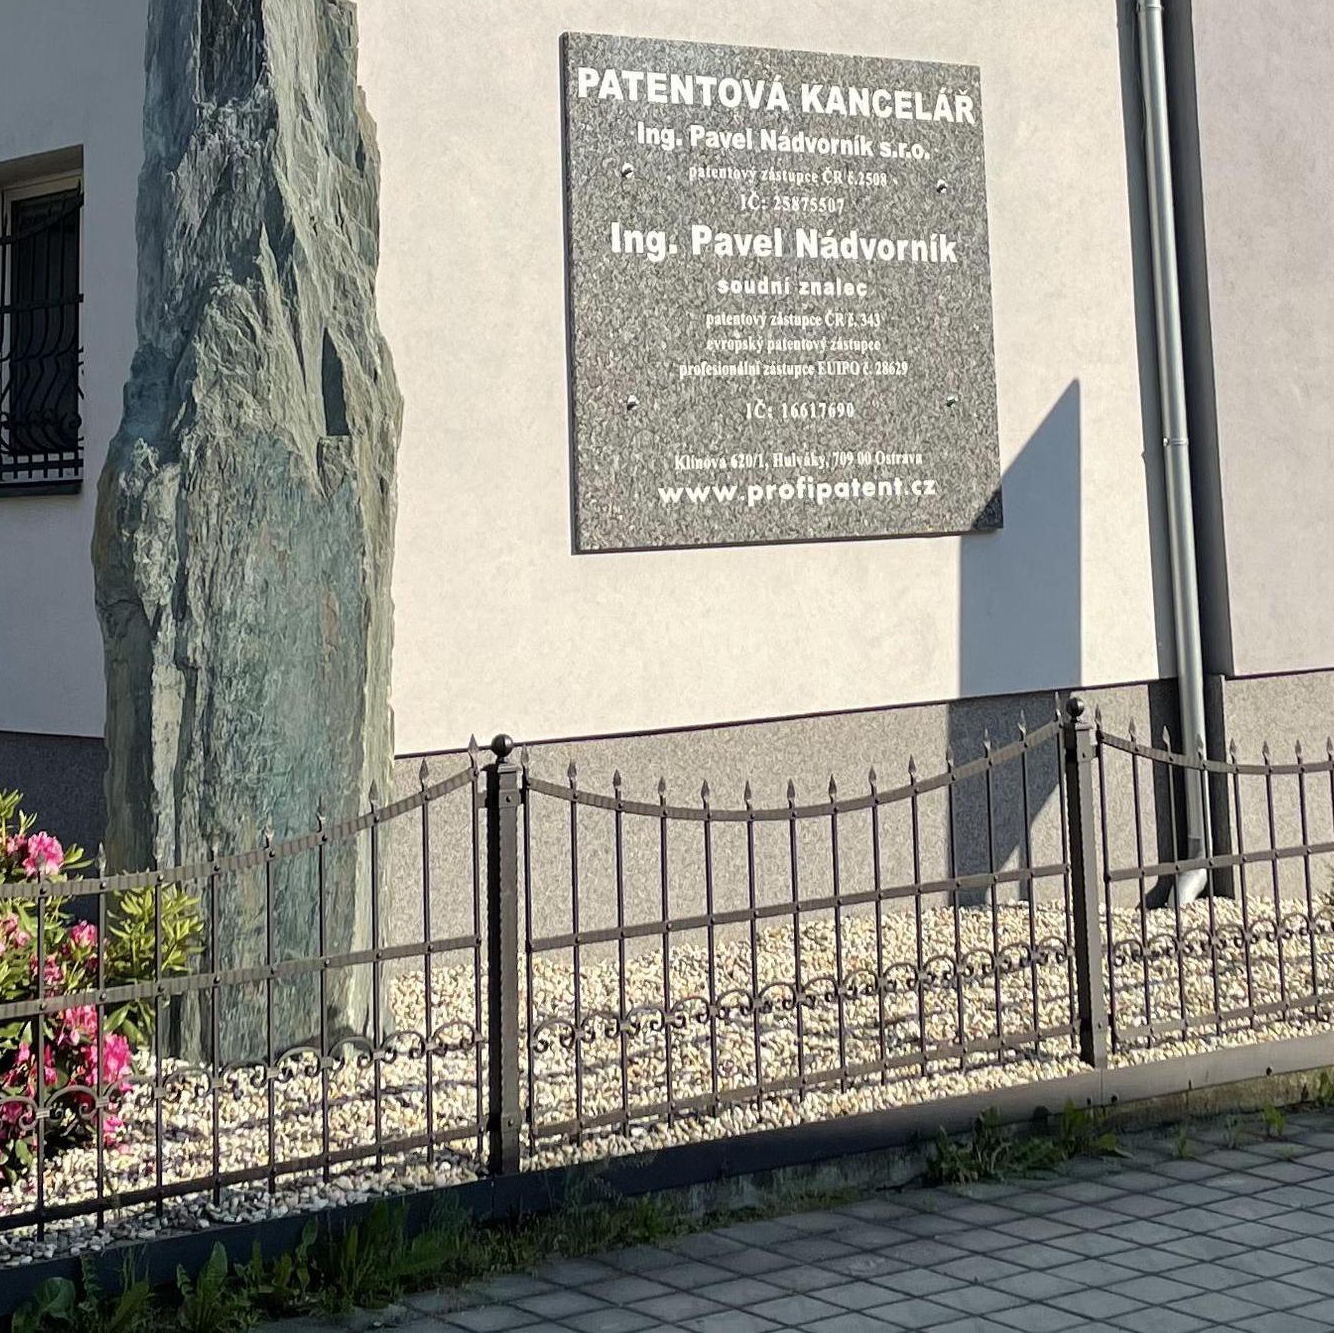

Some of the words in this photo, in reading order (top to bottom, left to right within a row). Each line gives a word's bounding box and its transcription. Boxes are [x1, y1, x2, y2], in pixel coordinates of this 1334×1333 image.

[577, 66, 790, 112] PATENTOVÁ
[801, 78, 975, 125] KANCELÁŘ
[637, 120, 683, 151] Ing.
[690, 124, 753, 150] Pavel
[760, 127, 874, 157] Nádvorník
[879, 141, 931, 160] s.r.o.
[688, 166, 757, 183] patentový
[761, 167, 818, 186] zástupce
[822, 167, 843, 183] ČR
[741, 189, 767, 211] IČ:
[773, 195, 845, 215] 25875507
[611, 222, 678, 261] Ing.
[691, 224, 783, 257] Pavel
[795, 227, 958, 263] Nádvorník
[717, 276, 790, 295] soudní
[798, 278, 868, 297] znalec
[706, 311, 767, 329] patentový
[770, 311, 822, 329] zástupce
[824, 309, 845, 327] ČR
[706, 335, 764, 354] evropský
[767, 336, 827, 354] patentový
[829, 336, 881, 354] zástupce
[763, 361, 815, 379] zástupce
[781, 403, 855, 419] 16617690
[657, 476, 936, 507] www.profipatent.cz
